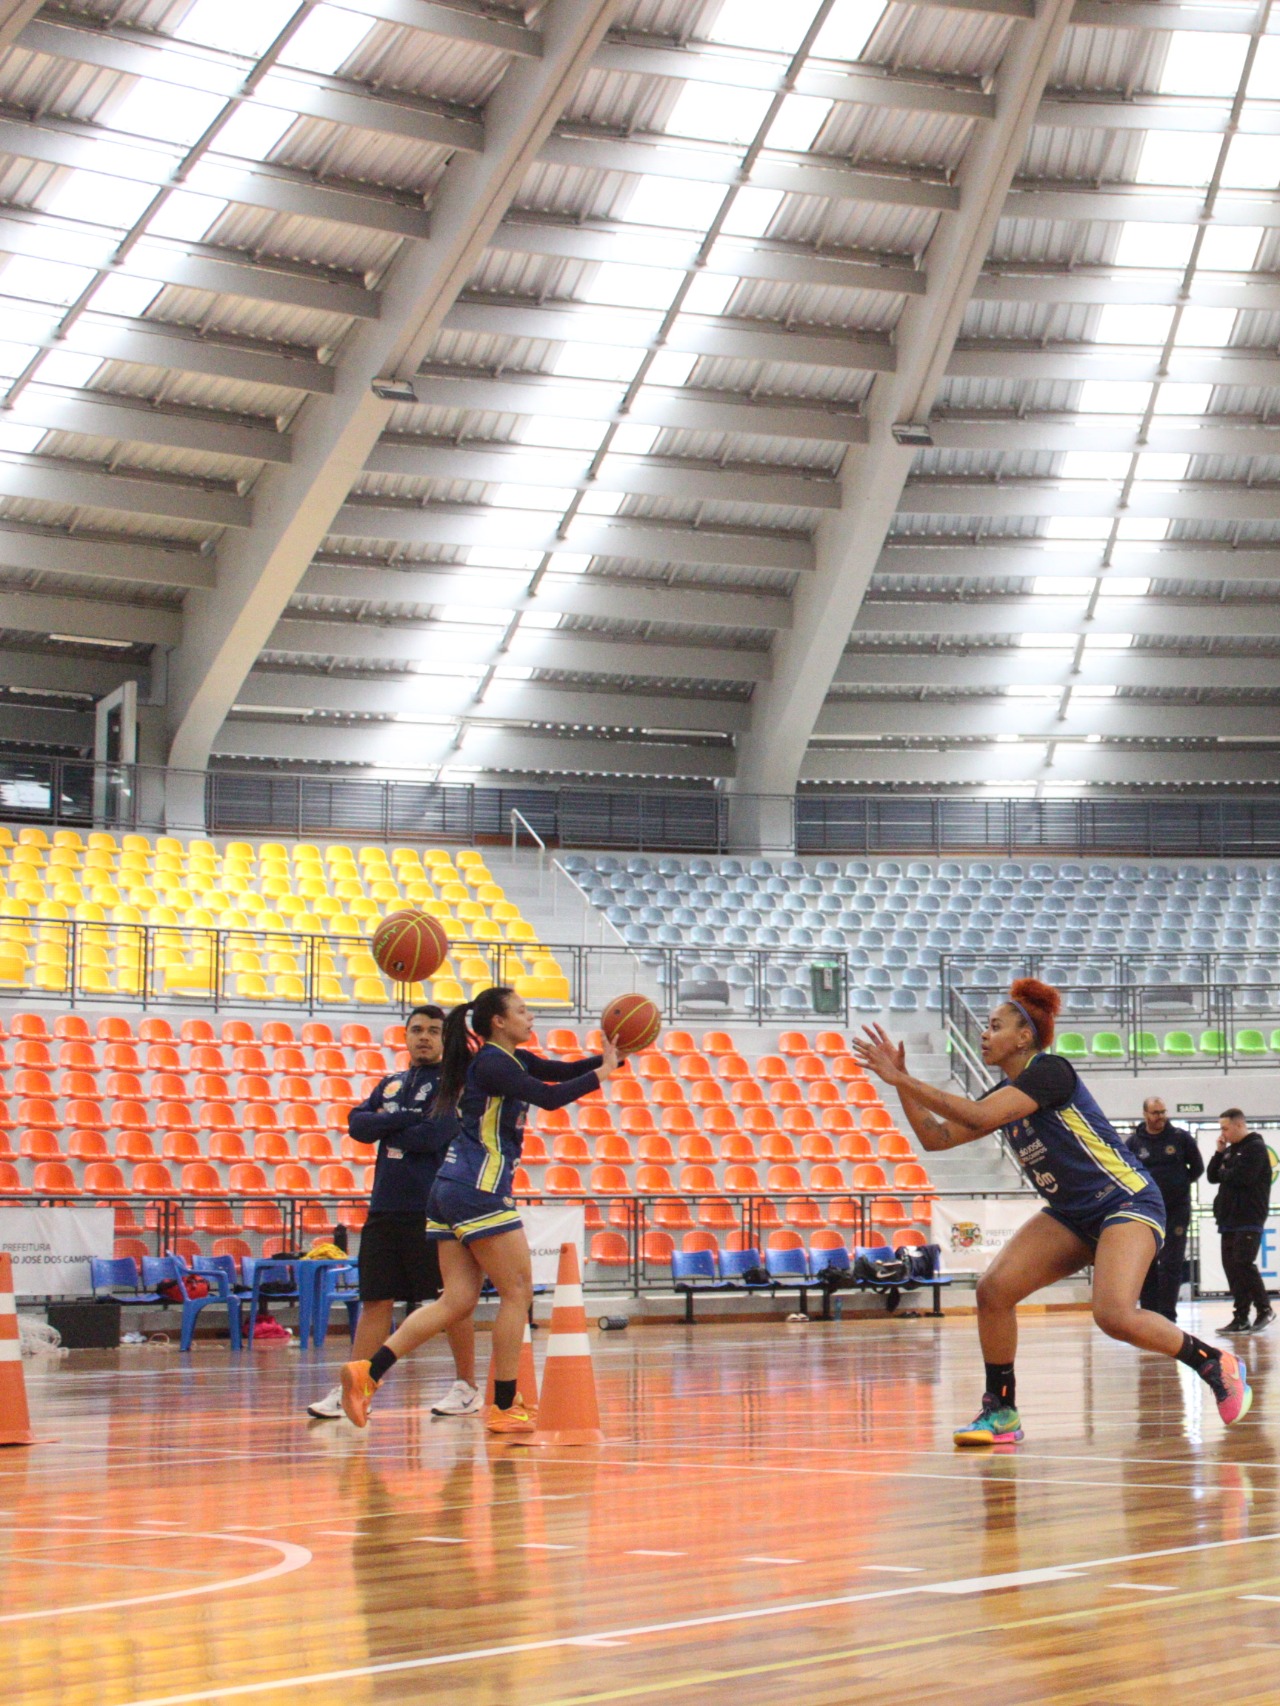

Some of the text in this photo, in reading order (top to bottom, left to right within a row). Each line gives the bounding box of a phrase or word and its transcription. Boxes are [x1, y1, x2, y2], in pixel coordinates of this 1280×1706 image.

[2, 1243, 51, 1252] PREFEITURA
[21, 1255, 43, 1264] JOSÉ
[44, 1256, 61, 1264] DOS
